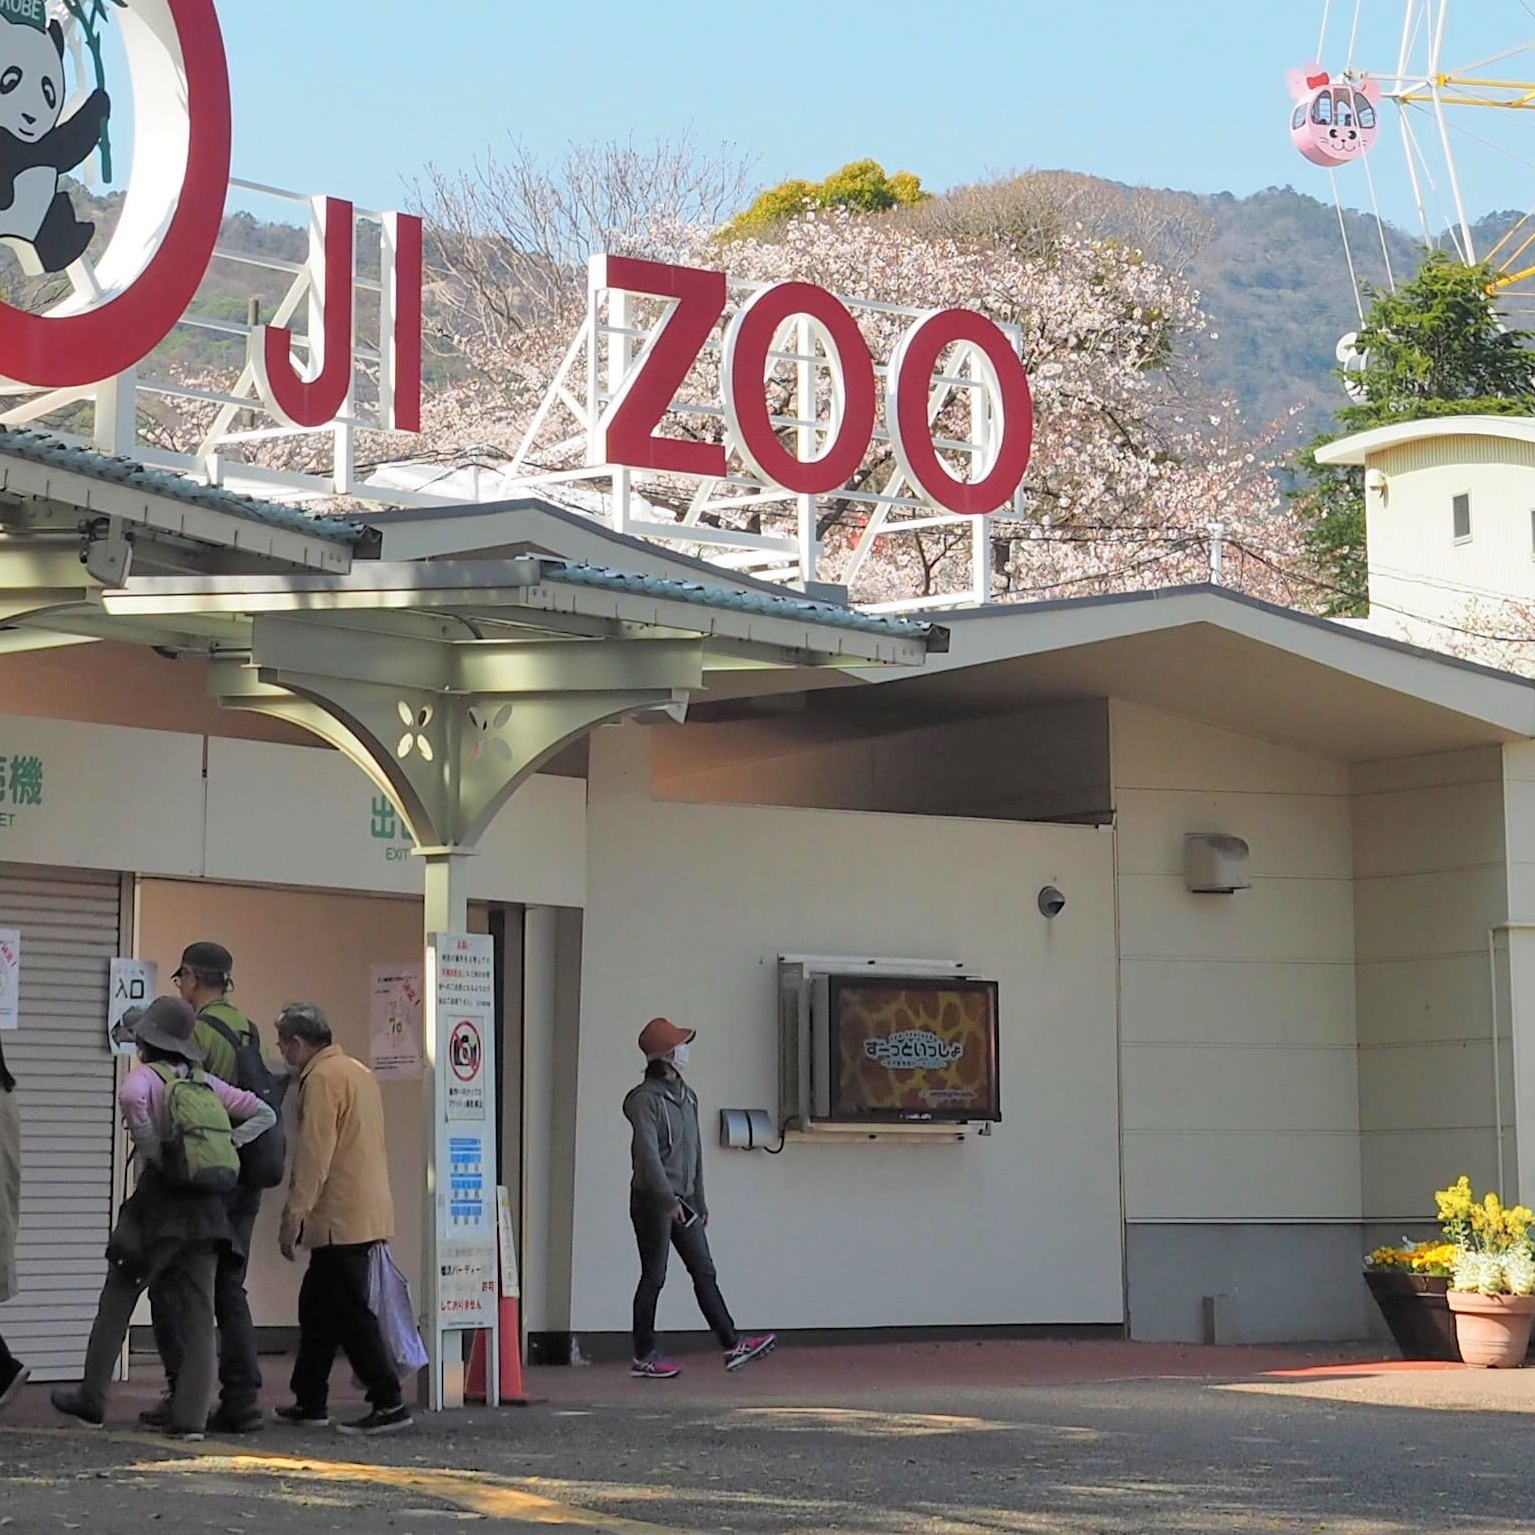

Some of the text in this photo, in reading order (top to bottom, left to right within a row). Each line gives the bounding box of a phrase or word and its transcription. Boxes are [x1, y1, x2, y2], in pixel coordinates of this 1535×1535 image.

[589, 254, 1033, 515] ZOO
[385, 846, 410, 862] EXIT
[115, 977, 145, 1000] 入口
